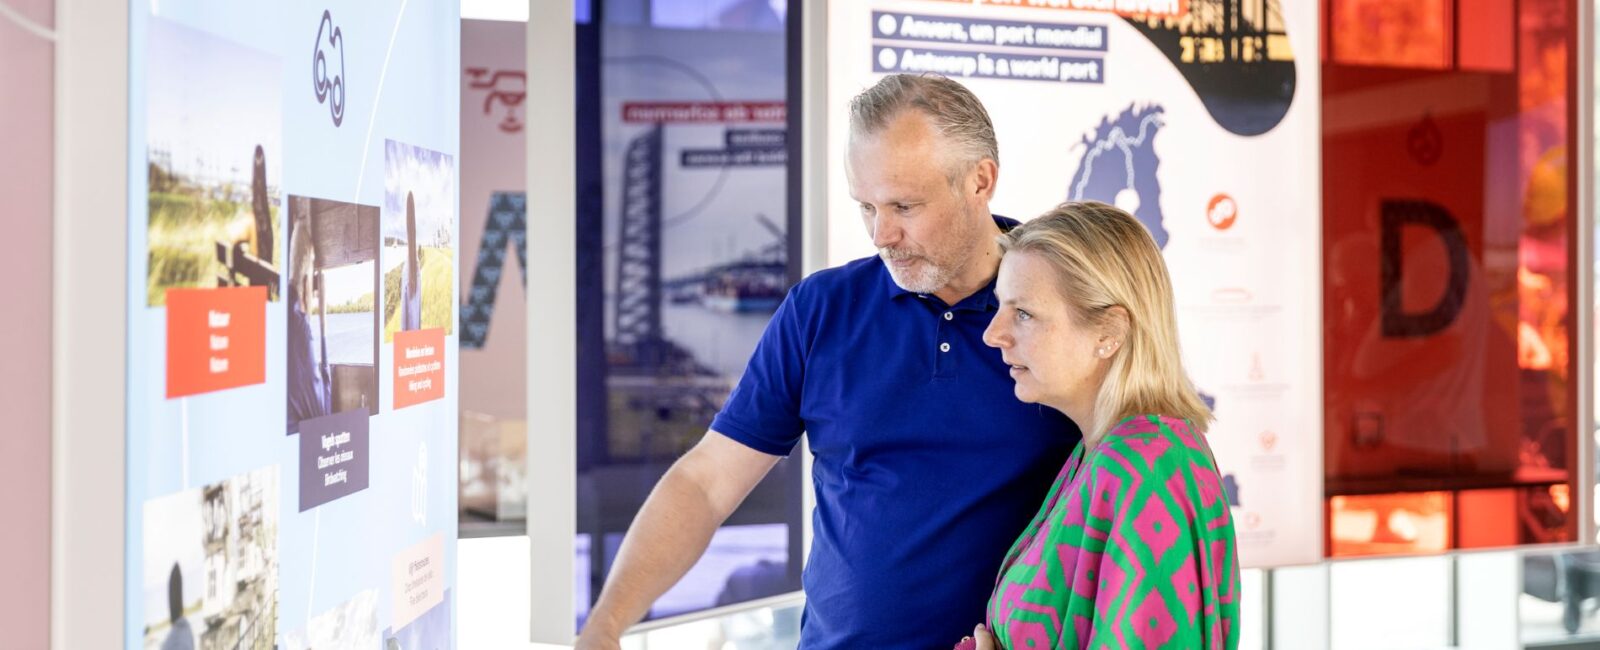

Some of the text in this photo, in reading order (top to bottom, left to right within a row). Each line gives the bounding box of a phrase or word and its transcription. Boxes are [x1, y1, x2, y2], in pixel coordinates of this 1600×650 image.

[901, 15, 968, 42] Anvers,
[970, 24, 994, 42] un
[995, 25, 1034, 46] port
[901, 49, 1098, 82] Antwerp is a world port
[1380, 199, 1470, 339] D
